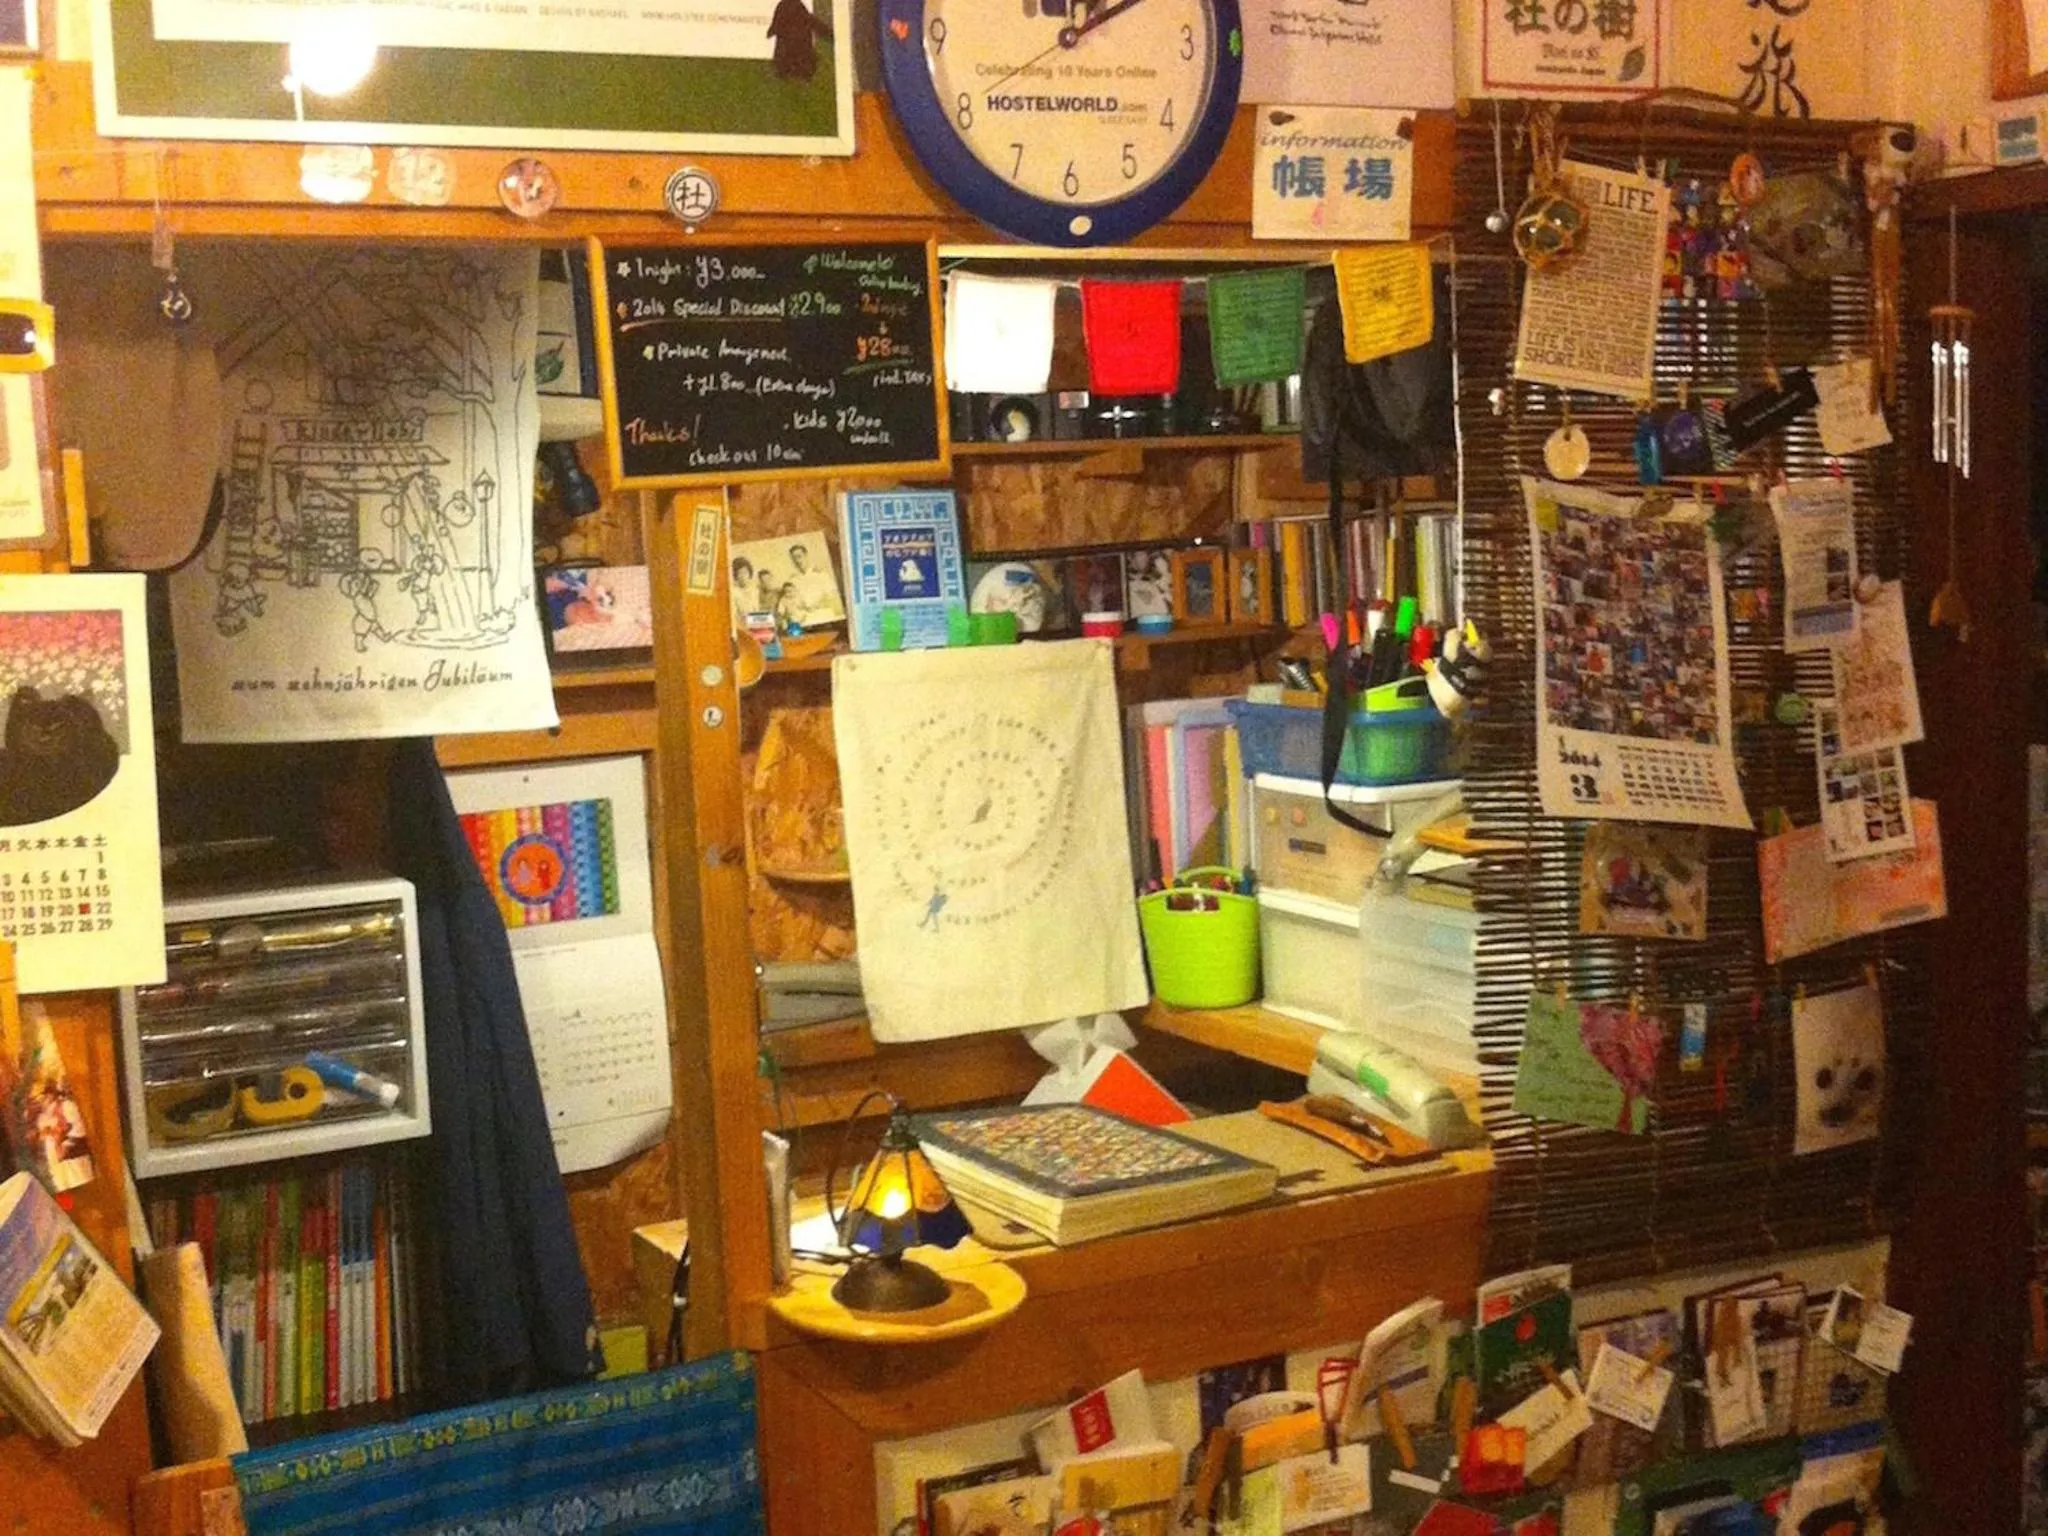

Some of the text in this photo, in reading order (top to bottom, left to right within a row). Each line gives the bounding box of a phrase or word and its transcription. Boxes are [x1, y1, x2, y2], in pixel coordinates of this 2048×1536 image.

[929, 17, 947, 55] 9
[1179, 24, 1195, 61] 3
[956, 91, 974, 131] 8
[1158, 98, 1175, 132] 4
[1009, 143, 1024, 180] 7
[1063, 160, 1080, 197] 6
[1121, 143, 1138, 179] 5
[673, 298, 723, 319] Special
[657, 342, 710, 362] Private
[78, 868, 87, 882] 7
